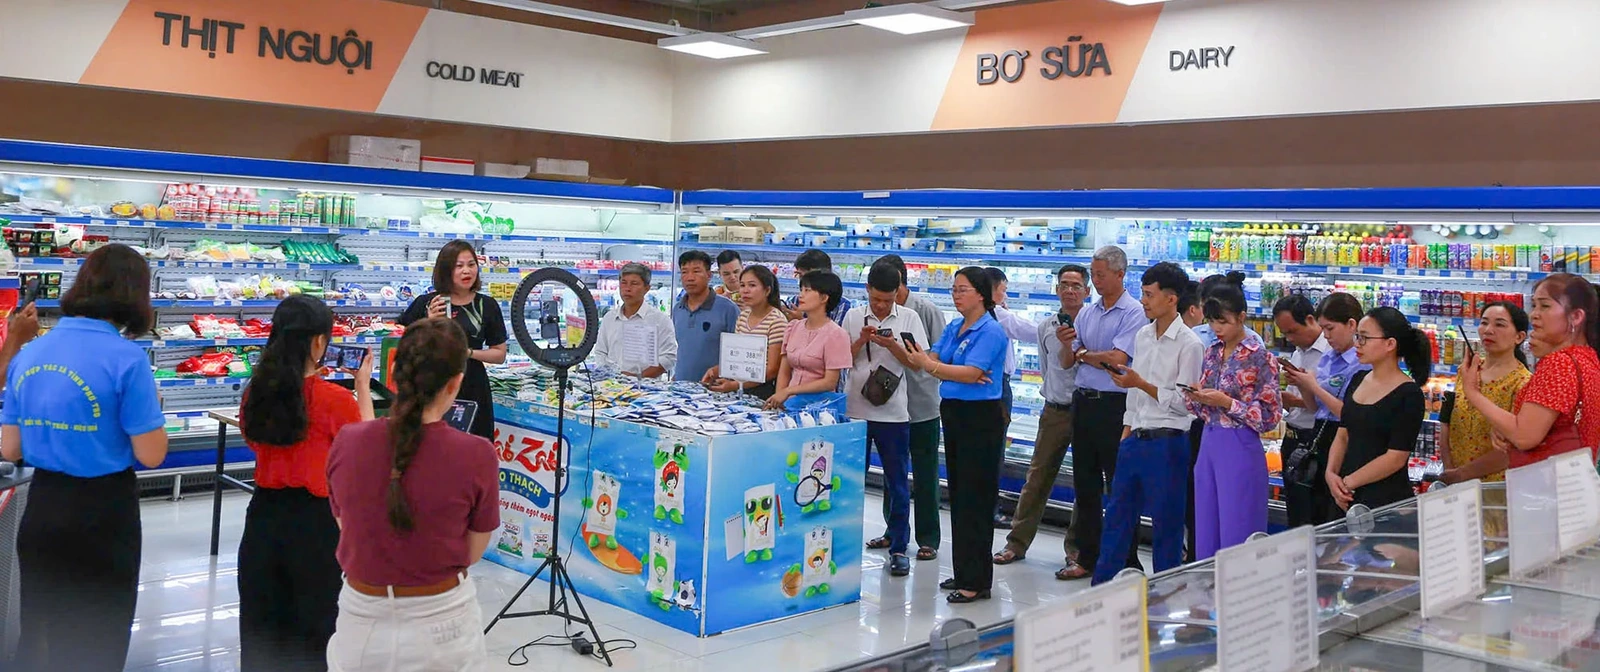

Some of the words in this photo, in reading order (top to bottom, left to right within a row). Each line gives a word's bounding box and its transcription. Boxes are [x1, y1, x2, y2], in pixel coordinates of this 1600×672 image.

[154, 11, 245, 59] THỊT
[257, 27, 373, 75] NGUỘI
[976, 49, 1029, 85] BƠ
[1040, 35, 1112, 81] SỮA
[1169, 45, 1235, 71] DAIRY
[426, 61, 475, 82] COLD
[479, 67, 524, 88] MEAT
[509, 472, 542, 497] THẠCH
